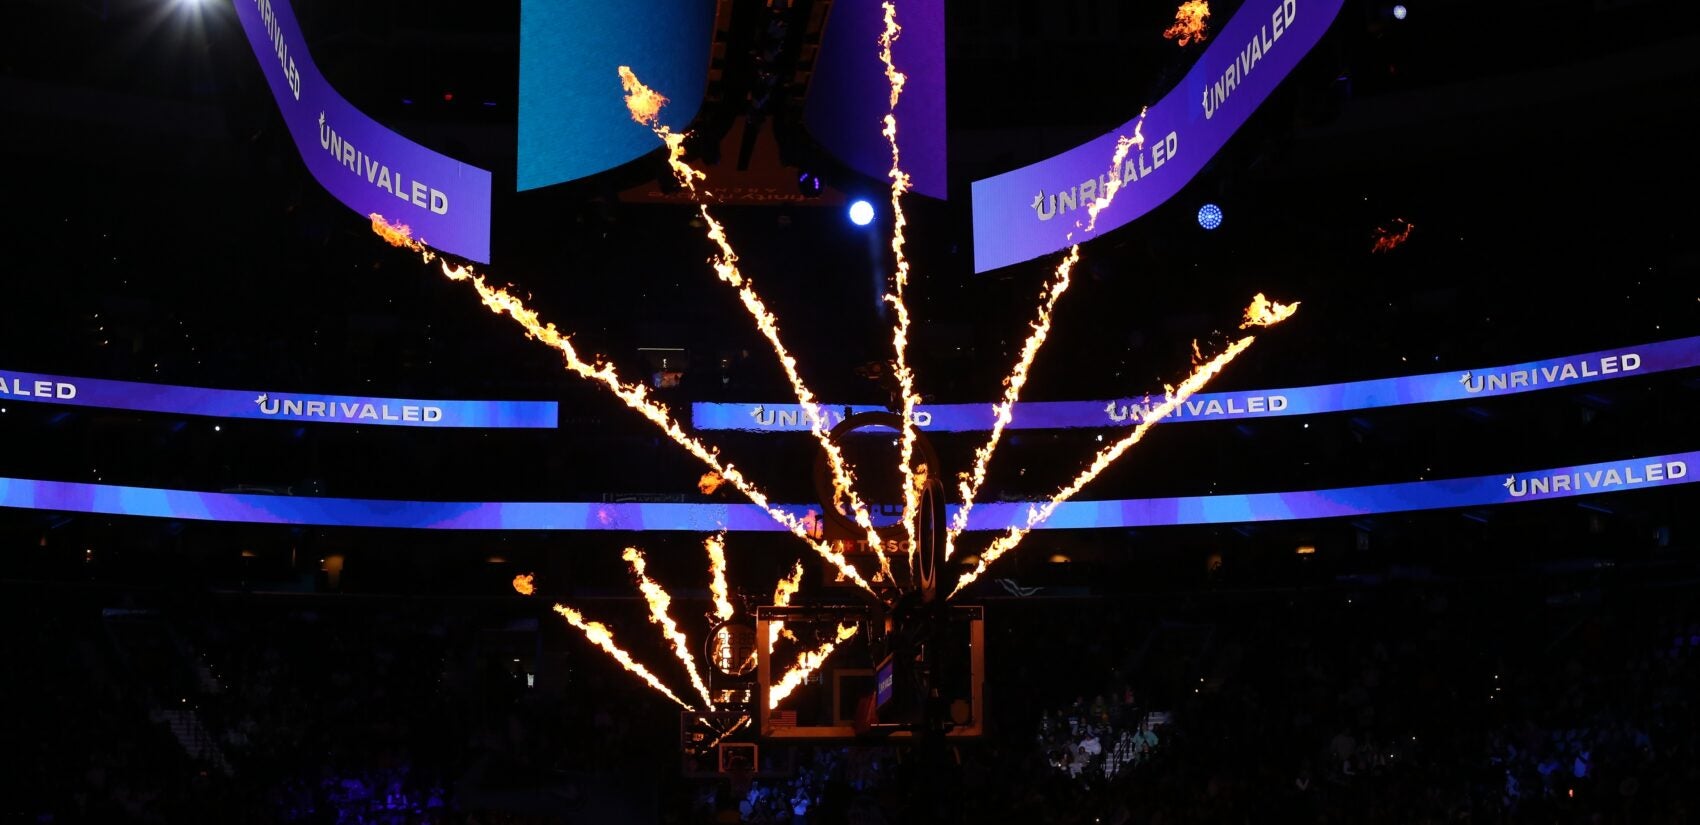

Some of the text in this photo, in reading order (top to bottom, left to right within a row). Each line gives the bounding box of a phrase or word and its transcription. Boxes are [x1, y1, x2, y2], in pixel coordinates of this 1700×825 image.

[254, 0, 300, 101] NRIVALED
[1202, 0, 1296, 120] UNRIVALED
[318, 110, 449, 216] UNRIVALED
[254, 393, 442, 422] UNRIVALED
[1459, 353, 1641, 393] UNRIVALED
[1503, 461, 1687, 497] UNRIVALED
